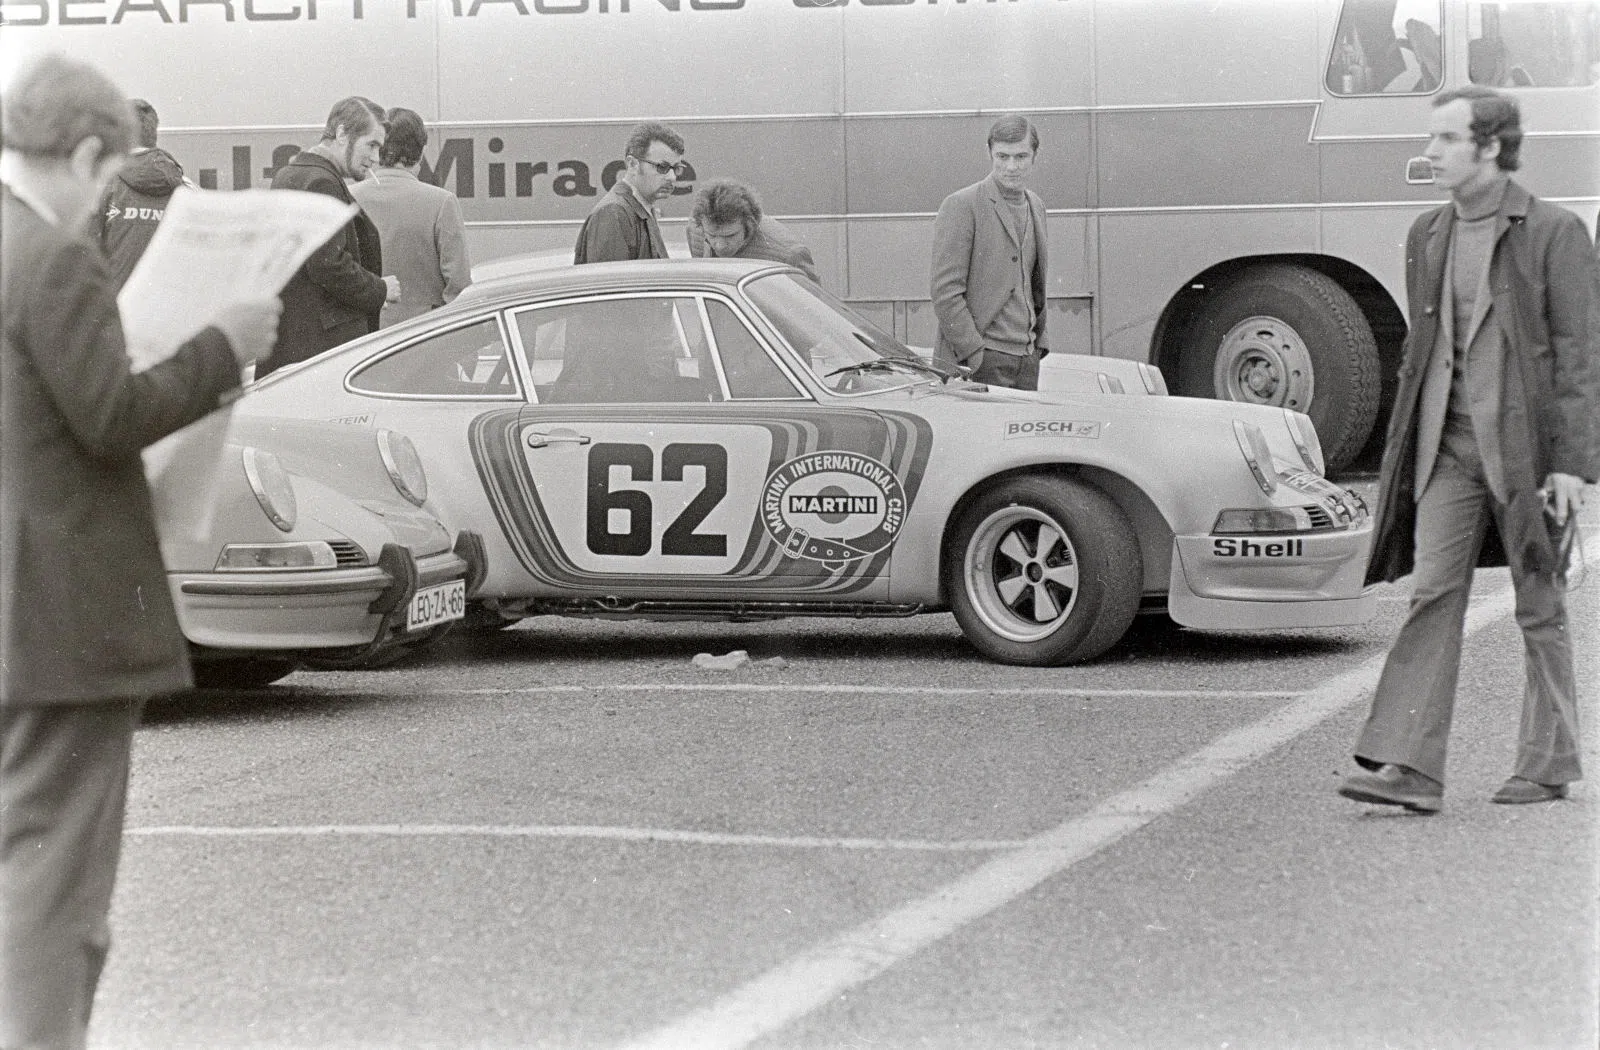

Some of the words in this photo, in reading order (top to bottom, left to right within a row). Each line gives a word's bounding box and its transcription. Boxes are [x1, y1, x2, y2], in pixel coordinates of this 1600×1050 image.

[418, 136, 697, 198] Mirae
[1008, 421, 1073, 434] BOSCH
[586, 442, 728, 557] 62
[765, 473, 790, 534] MARTINI
[789, 455, 896, 495] INTERNATIONAL
[882, 498, 902, 534] CLUB
[791, 497, 876, 513] MARTINI
[1213, 538, 1303, 557] Shell
